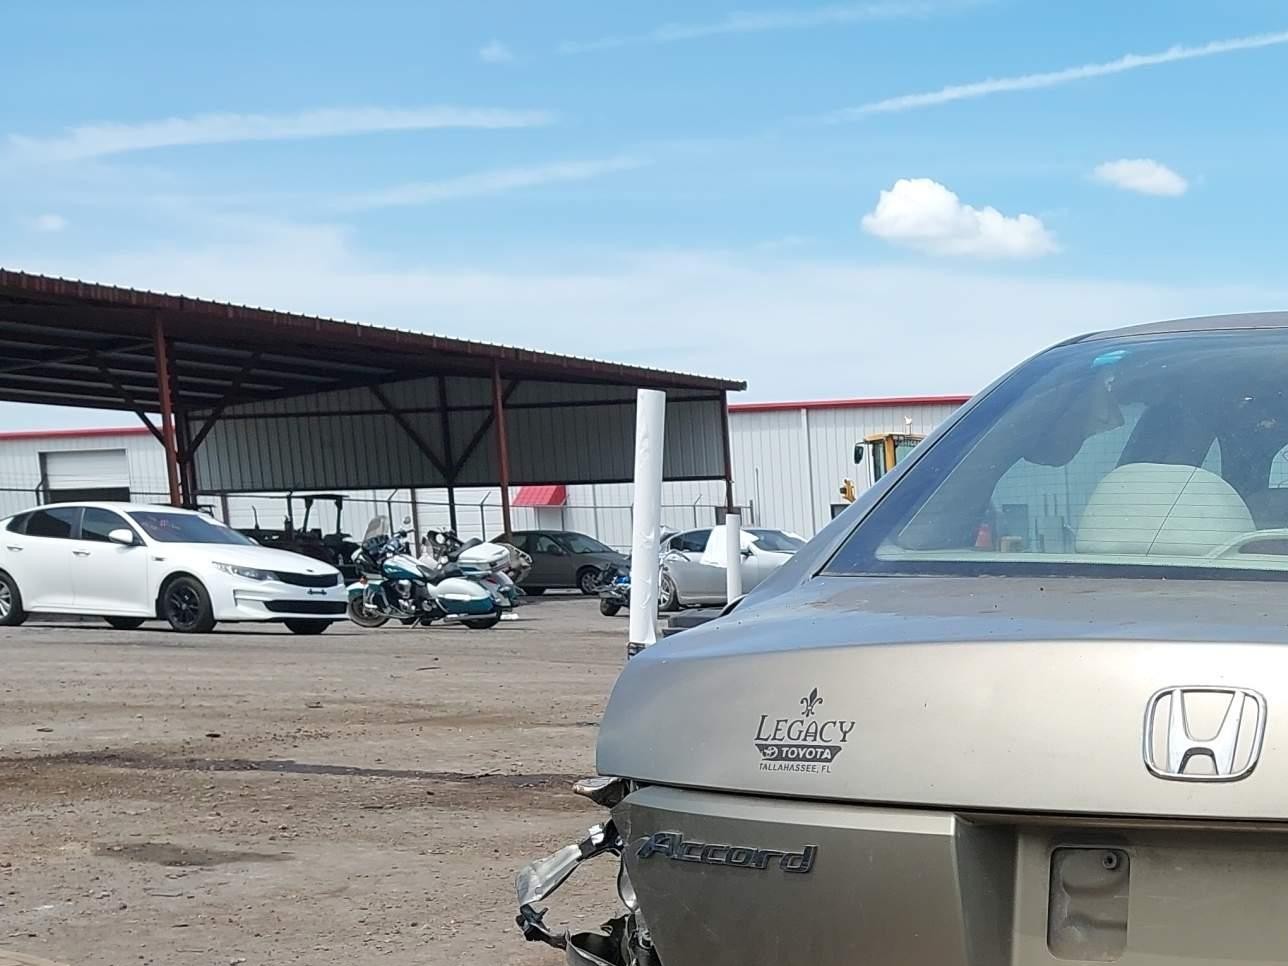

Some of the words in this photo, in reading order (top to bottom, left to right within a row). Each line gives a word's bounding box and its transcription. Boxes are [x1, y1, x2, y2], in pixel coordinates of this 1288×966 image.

[754, 714, 856, 743] LEGACY
[781, 747, 832, 760] TOYOTA
[821, 764, 832, 774] FL
[636, 830, 819, 873] Accord
